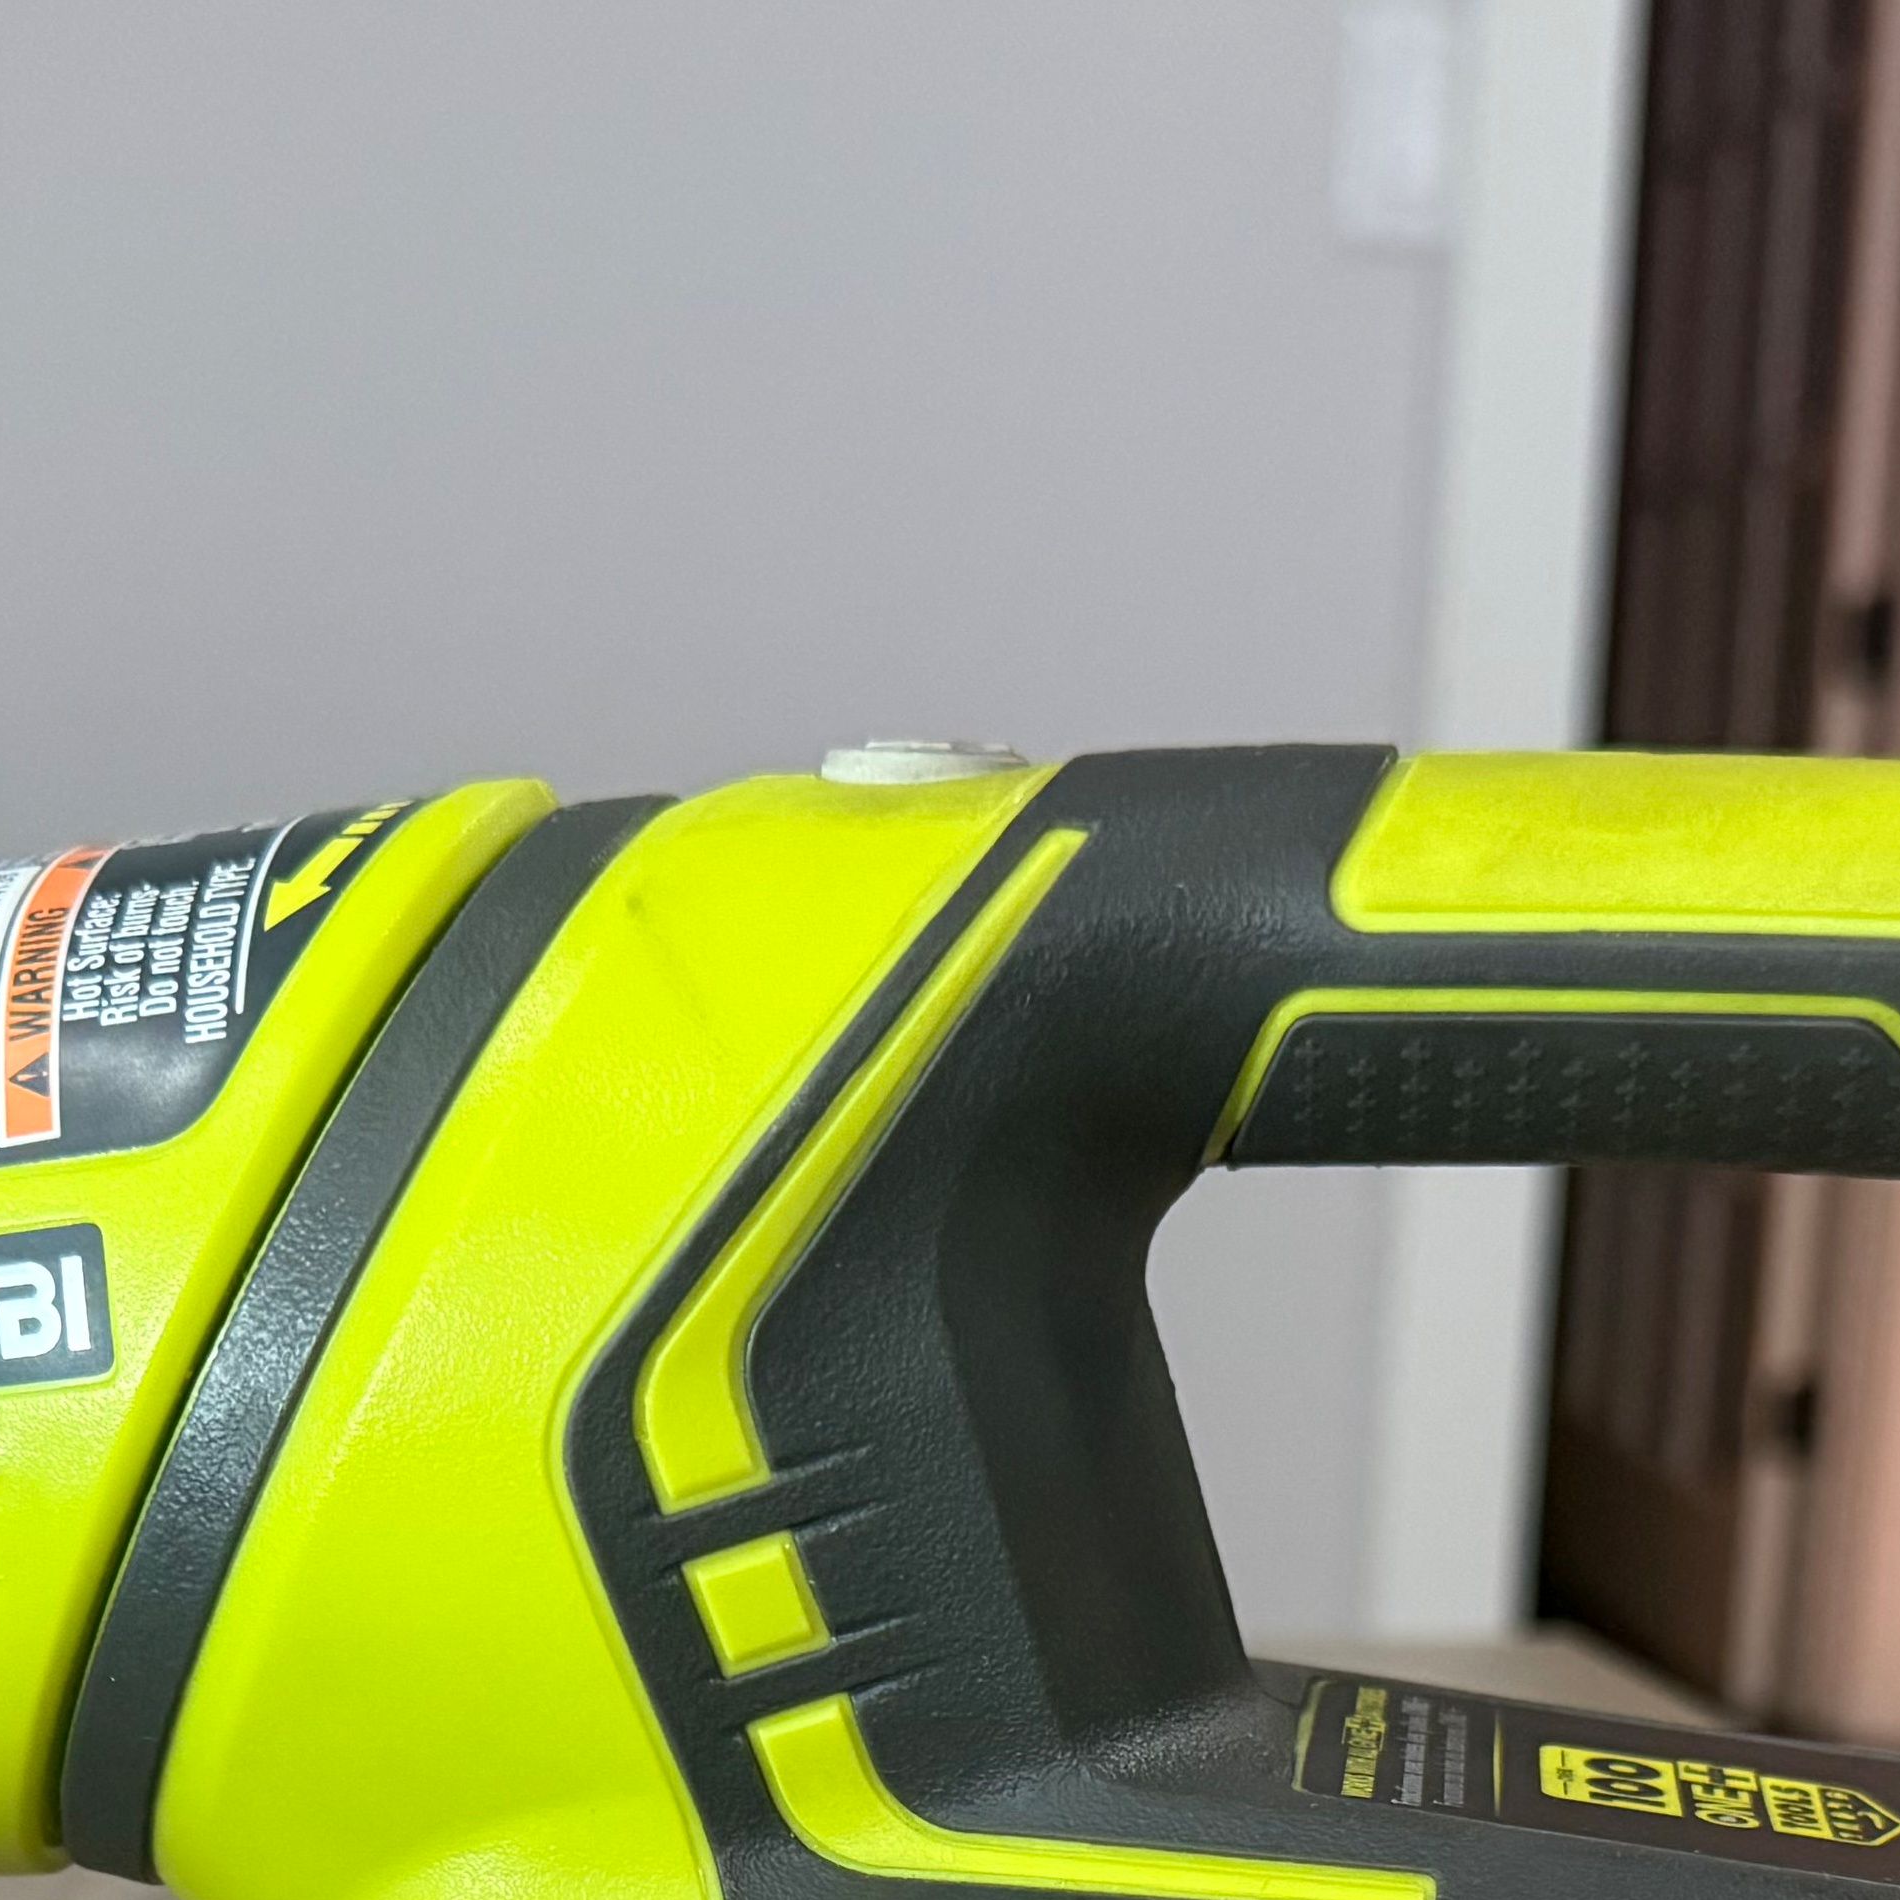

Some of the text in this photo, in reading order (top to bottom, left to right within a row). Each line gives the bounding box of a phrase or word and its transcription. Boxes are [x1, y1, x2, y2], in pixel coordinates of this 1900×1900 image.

[9, 907, 66, 1042] WARNING
[109, 941, 145, 965] of
[149, 937, 185, 975] not
[185, 902, 241, 1043] HOUSEHOLD
[62, 974, 103, 1022] Hot
[100, 966, 142, 1027] Risk
[139, 978, 179, 1017] Do
[1583, 1756, 1666, 1810] 100
[1770, 1784, 1819, 1832] TOOLS
